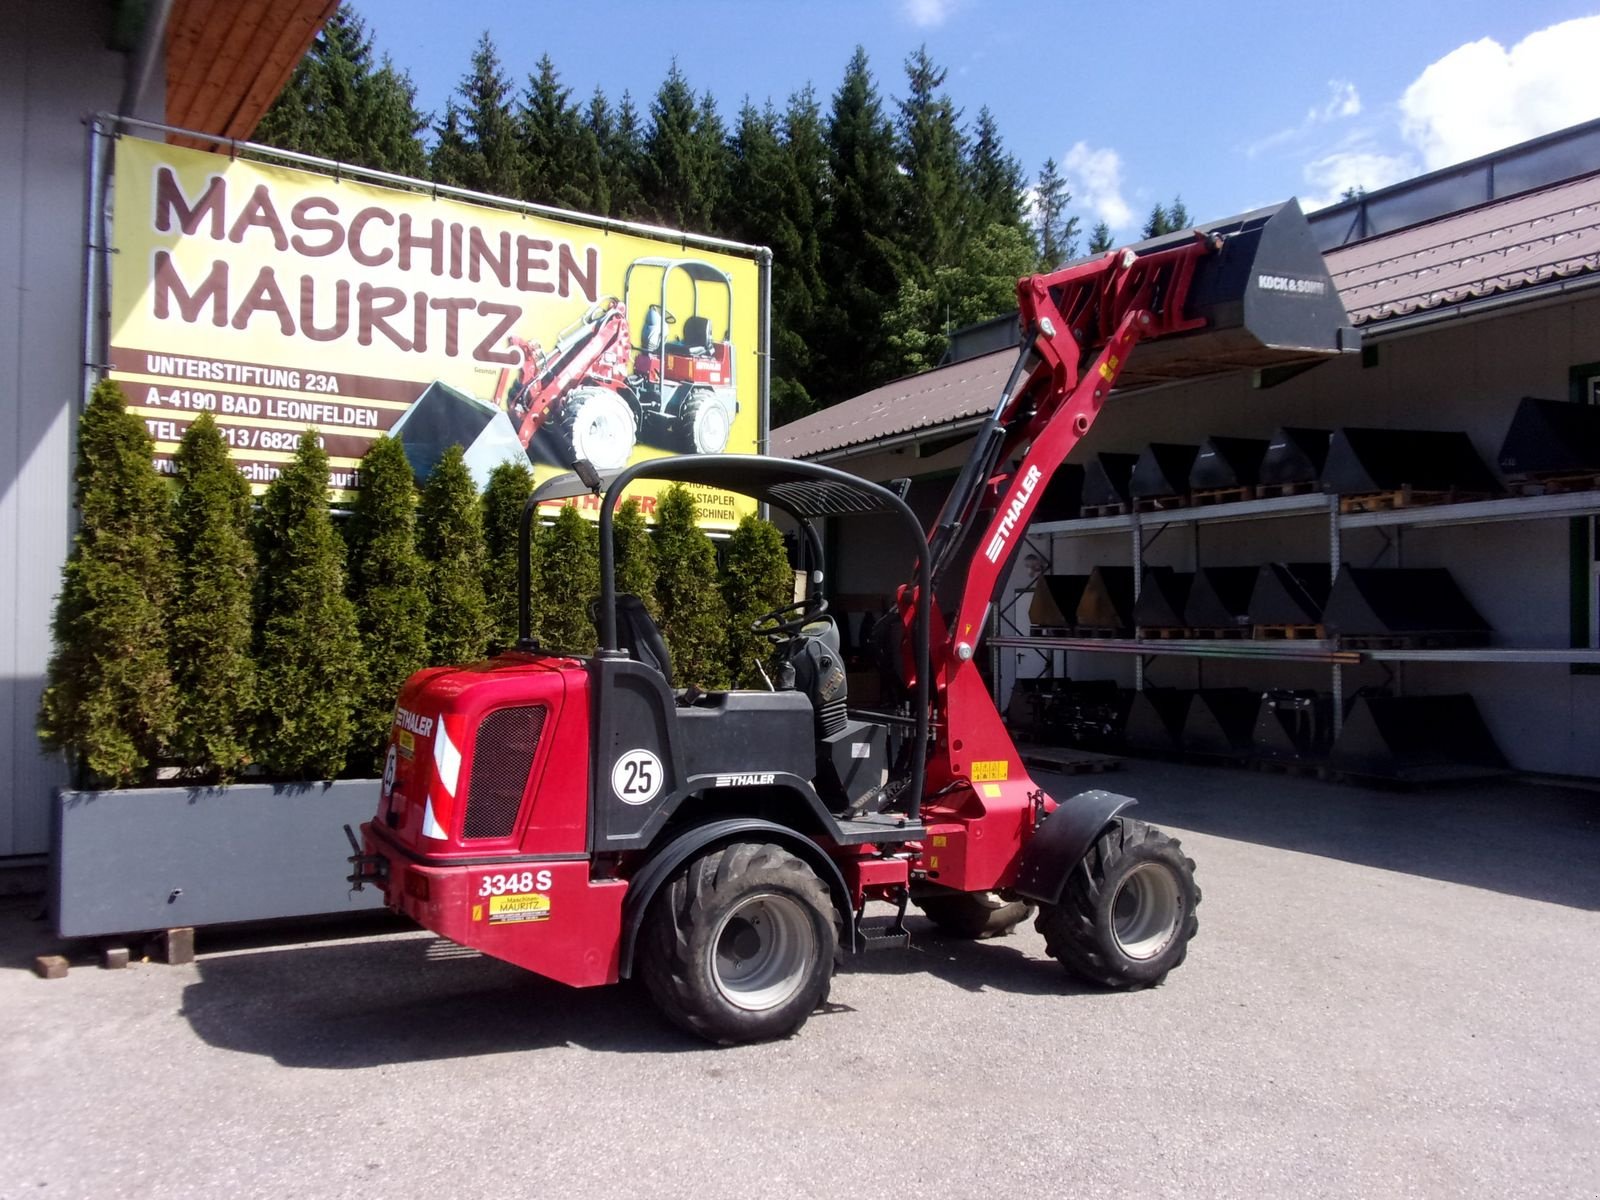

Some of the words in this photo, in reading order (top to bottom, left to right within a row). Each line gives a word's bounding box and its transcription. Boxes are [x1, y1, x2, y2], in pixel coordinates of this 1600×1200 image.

[155, 167, 598, 303] MASCHINEN
[153, 250, 523, 366] MAURITZ
[146, 354, 301, 389] UNTERSTIFTUNG
[304, 373, 340, 394] 23A
[145, 386, 217, 412] A-4190
[221, 397, 261, 416] BAD
[266, 399, 378, 427] LEONFELDEN
[997, 464, 1043, 538] THALER
[401, 708, 434, 738] THALER
[623, 760, 653, 795] 25
[730, 775, 775, 787] THALER
[478, 871, 534, 897] 3348
[535, 869, 552, 891] S
[499, 901, 541, 912] MAURITZ
